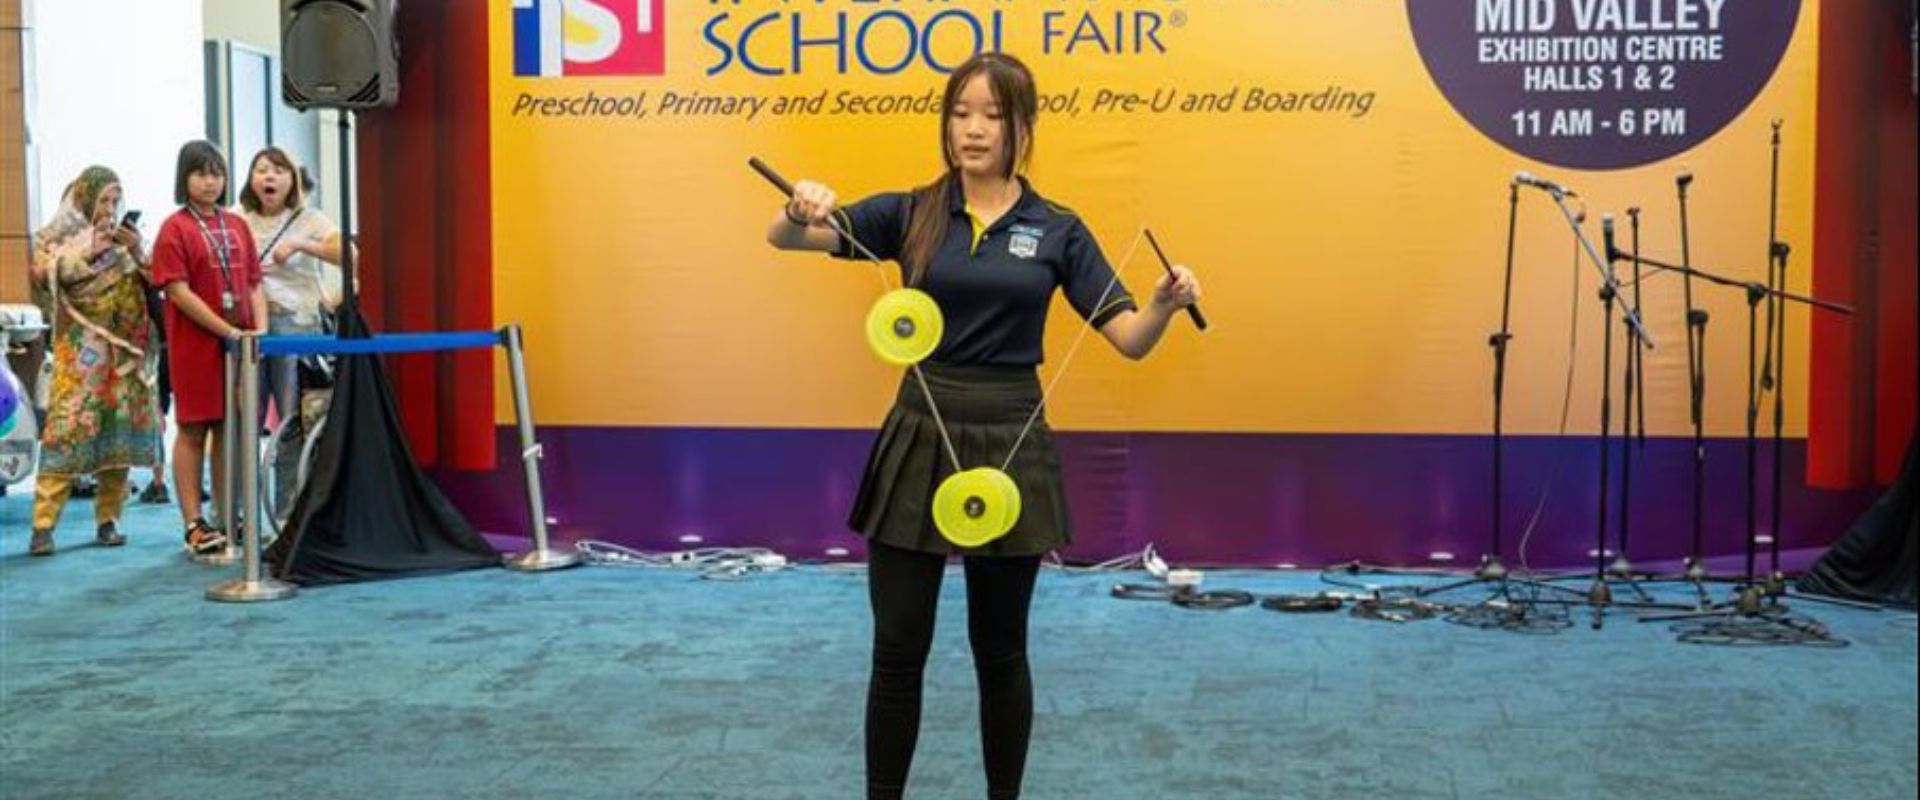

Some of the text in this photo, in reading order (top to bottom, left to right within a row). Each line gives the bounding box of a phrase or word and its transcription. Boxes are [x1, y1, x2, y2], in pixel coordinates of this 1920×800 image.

[1475, 0, 1726, 32] MID VALLEY
[1478, 35, 1723, 63] EXHIBITION CENTRE
[1524, 64, 1675, 91] HALLS 1 & 2
[512, 91, 647, 119] Preschool,
[658, 91, 768, 121] Primary
[771, 89, 828, 115] and
[1091, 88, 1177, 113] Pre-U
[1180, 87, 1238, 112] and
[1242, 87, 1376, 118] Boarding
[1511, 110, 1541, 136] 11
[1550, 110, 1593, 136] AM
[1619, 110, 1635, 136] 6
[1643, 109, 1686, 135] PM
